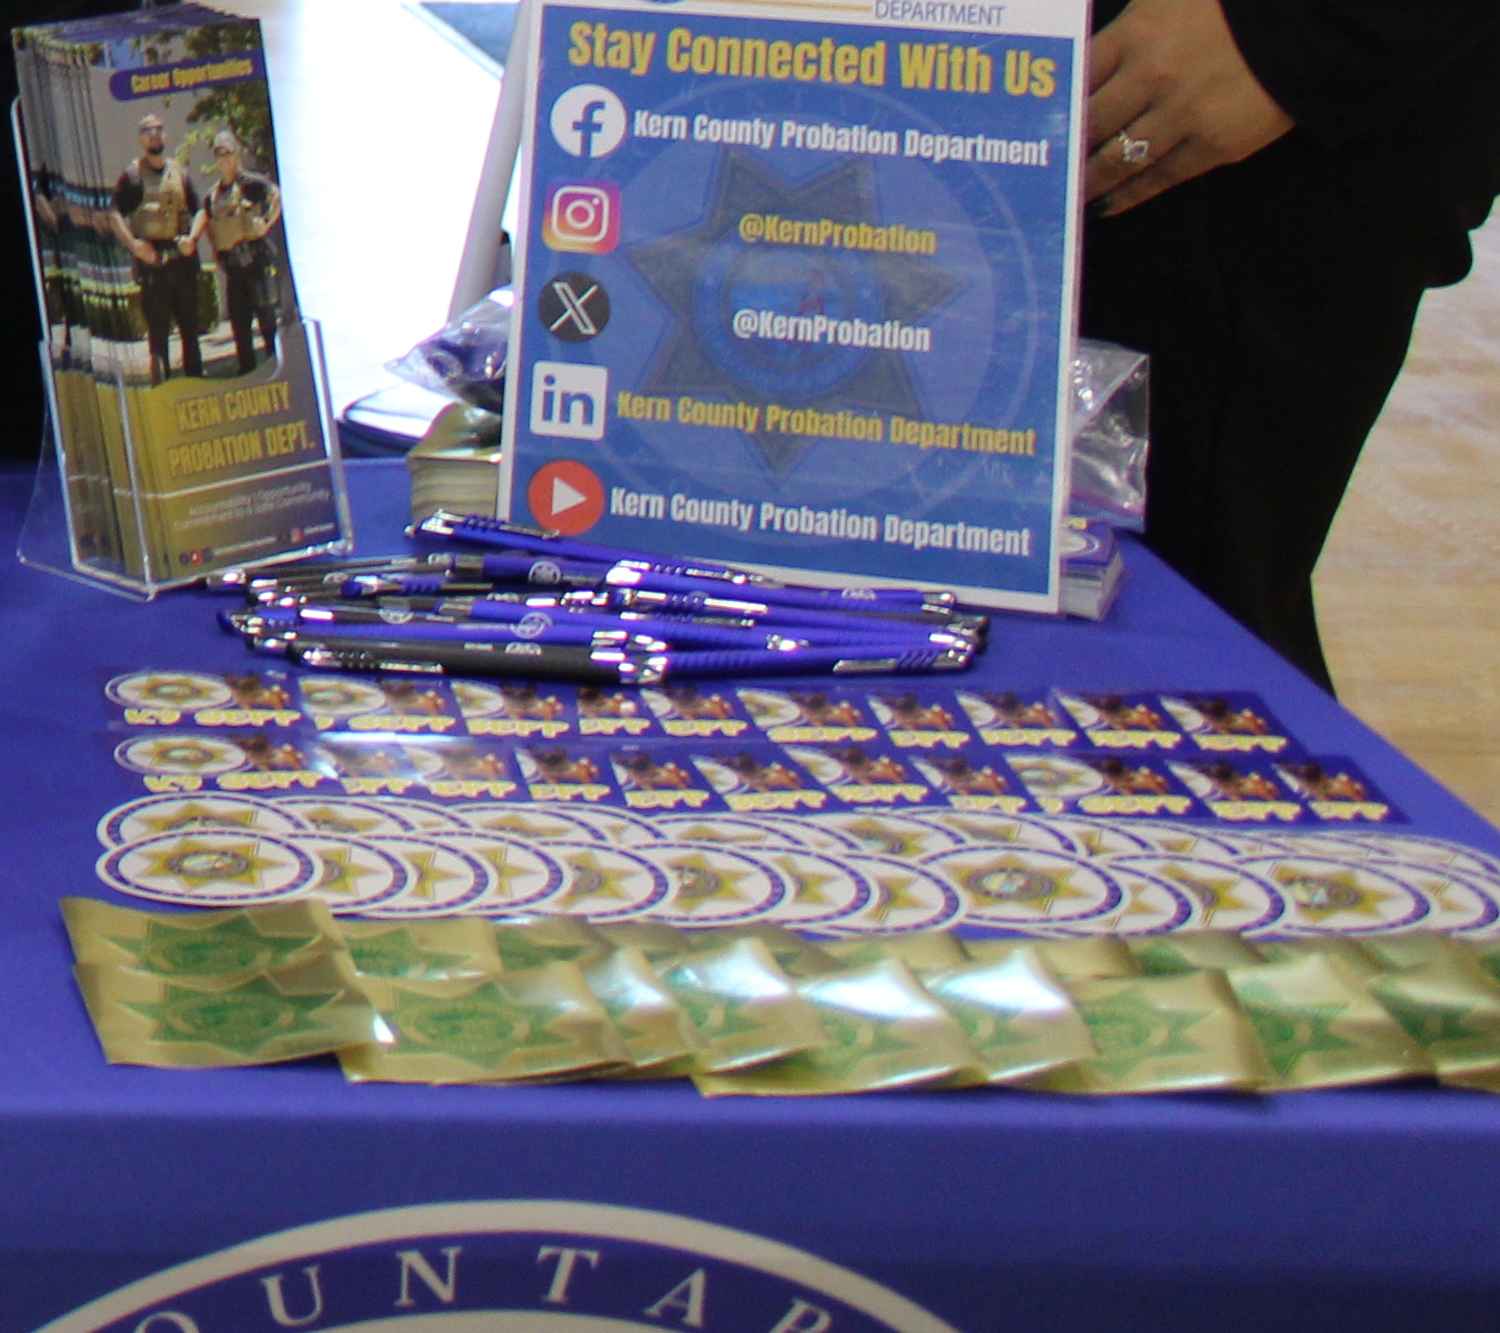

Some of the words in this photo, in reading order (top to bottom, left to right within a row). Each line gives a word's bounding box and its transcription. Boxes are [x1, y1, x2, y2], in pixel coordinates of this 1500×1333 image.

[567, 21, 657, 76] Stay
[666, 26, 889, 87] Connected
[898, 41, 994, 94] With
[1003, 49, 1057, 99] Us
[633, 109, 688, 140] Kern
[692, 113, 776, 150] County
[780, 119, 898, 156] Probation
[903, 128, 1050, 167] Department
[739, 212, 938, 256] @KernProbation
[732, 308, 932, 353] @KernProbation
[175, 397, 222, 432] KERN
[225, 381, 290, 420] COUNTY
[616, 390, 672, 421] Kern
[676, 395, 760, 433] County
[765, 403, 884, 442] Probation
[888, 415, 1037, 457] Department
[168, 430, 264, 476] PROBATION
[265, 420, 317, 456] DEPT.
[610, 486, 665, 520] Kern
[669, 491, 754, 532] County
[759, 501, 878, 542] Probation
[883, 513, 1033, 558] Department
